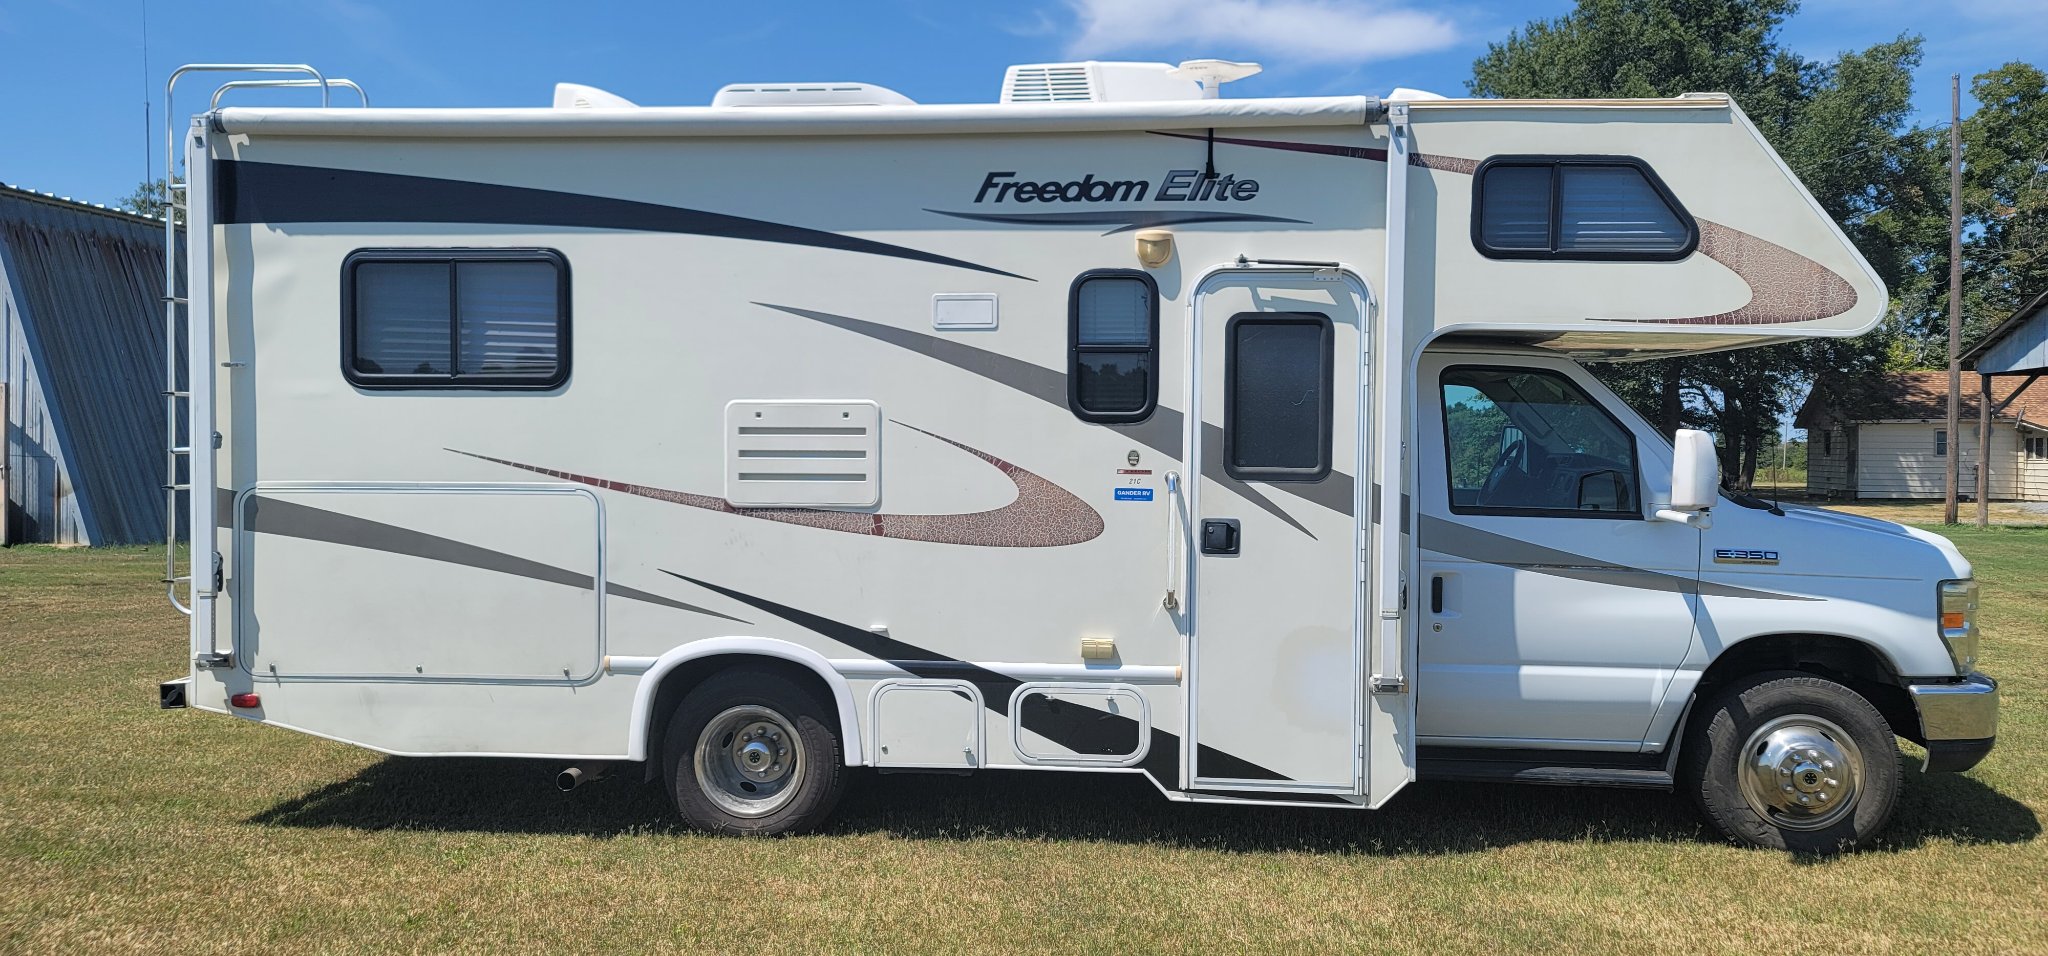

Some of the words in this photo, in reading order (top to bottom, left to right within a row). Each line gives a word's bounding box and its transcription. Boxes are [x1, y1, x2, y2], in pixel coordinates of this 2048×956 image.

[973, 171, 1150, 203] Freedom
[1154, 169, 1260, 202] Elite
[1716, 549, 1779, 560] E-350
